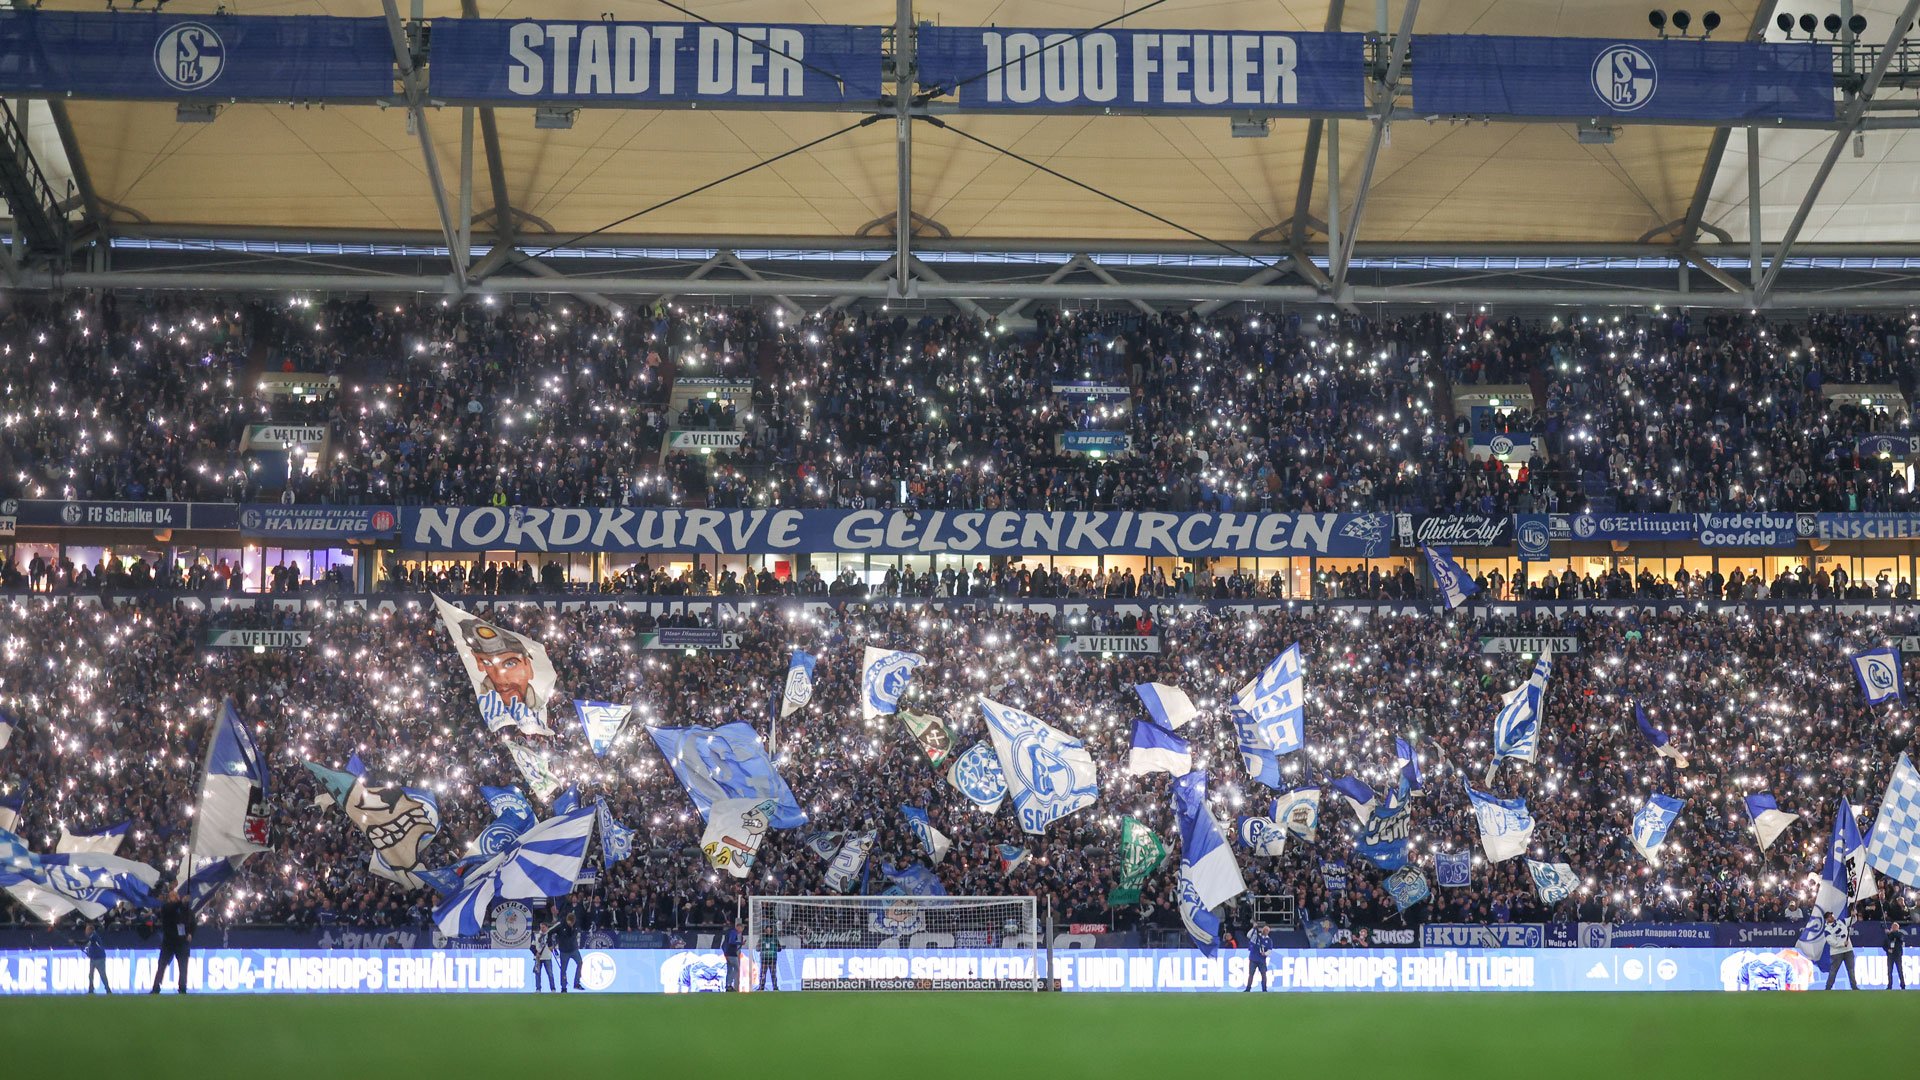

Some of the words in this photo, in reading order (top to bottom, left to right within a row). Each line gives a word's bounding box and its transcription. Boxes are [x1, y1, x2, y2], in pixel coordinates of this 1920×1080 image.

[508, 22, 684, 95] STADT
[697, 25, 804, 96] DER
[982, 31, 1117, 103] 1000
[1132, 33, 1298, 105] FEUER
[274, 429, 323, 440] VELTINS
[692, 434, 741, 445] VELTINS
[88, 506, 102, 522] FC
[105, 507, 153, 523] Schalke
[155, 508, 173, 523] 04
[265, 508, 323, 517] SCHALKER
[327, 509, 369, 518] FILIALE
[265, 517, 369, 531] HAMBURG
[414, 506, 802, 553] NORDKURVE
[833, 509, 1335, 557] GELSENKIRCHEN
[1701, 530, 1776, 546] Coesfeld
[242, 632, 302, 646] VELTINS
[1089, 637, 1149, 651] VELTINS
[1510, 638, 1570, 652] VELTINS
[1371, 928, 1415, 944] JUNGS
[1612, 929, 1644, 939] schosser
[1645, 928, 1678, 940] Knappen
[1678, 929, 1697, 939] 2002
[208, 956, 383, 990] S04-FANSHOPS
[387, 951, 525, 989] ERHÄLTLICH!
[1078, 957, 1128, 988] UND
[1130, 957, 1154, 988] IN
[1157, 957, 1225, 988] ALLEN
[1229, 956, 1397, 988] S-FANSHOPS
[1401, 951, 1534, 988] ERHÄLTLICH!
[802, 979, 866, 989] Eisenbach
[932, 979, 996, 989] Eisenbach
[998, 979, 1061, 989] Tresoe.e
